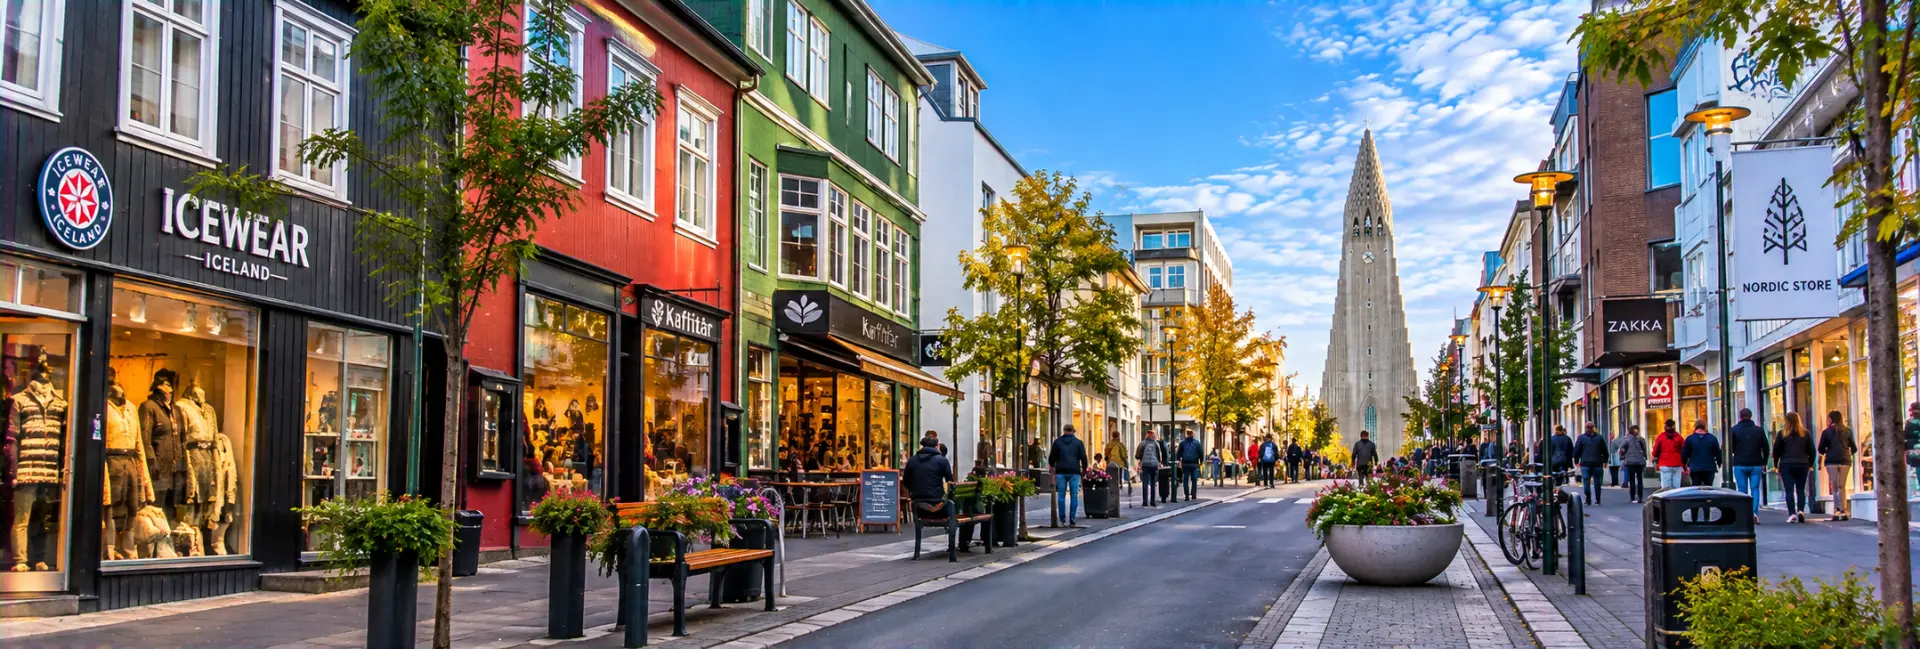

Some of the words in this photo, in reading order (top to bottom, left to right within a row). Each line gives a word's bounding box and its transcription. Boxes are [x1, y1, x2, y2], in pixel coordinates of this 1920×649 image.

[52, 153, 106, 189] ICEWEAR
[48, 214, 102, 244] ICELAND
[161, 187, 310, 268] ICEWEAR
[205, 252, 270, 281] ICELAND
[1742, 281, 1789, 293] NORDIC
[1793, 280, 1832, 291] STORE
[1607, 319, 1662, 332] ZAKKA
[1649, 377, 1670, 397] 66
